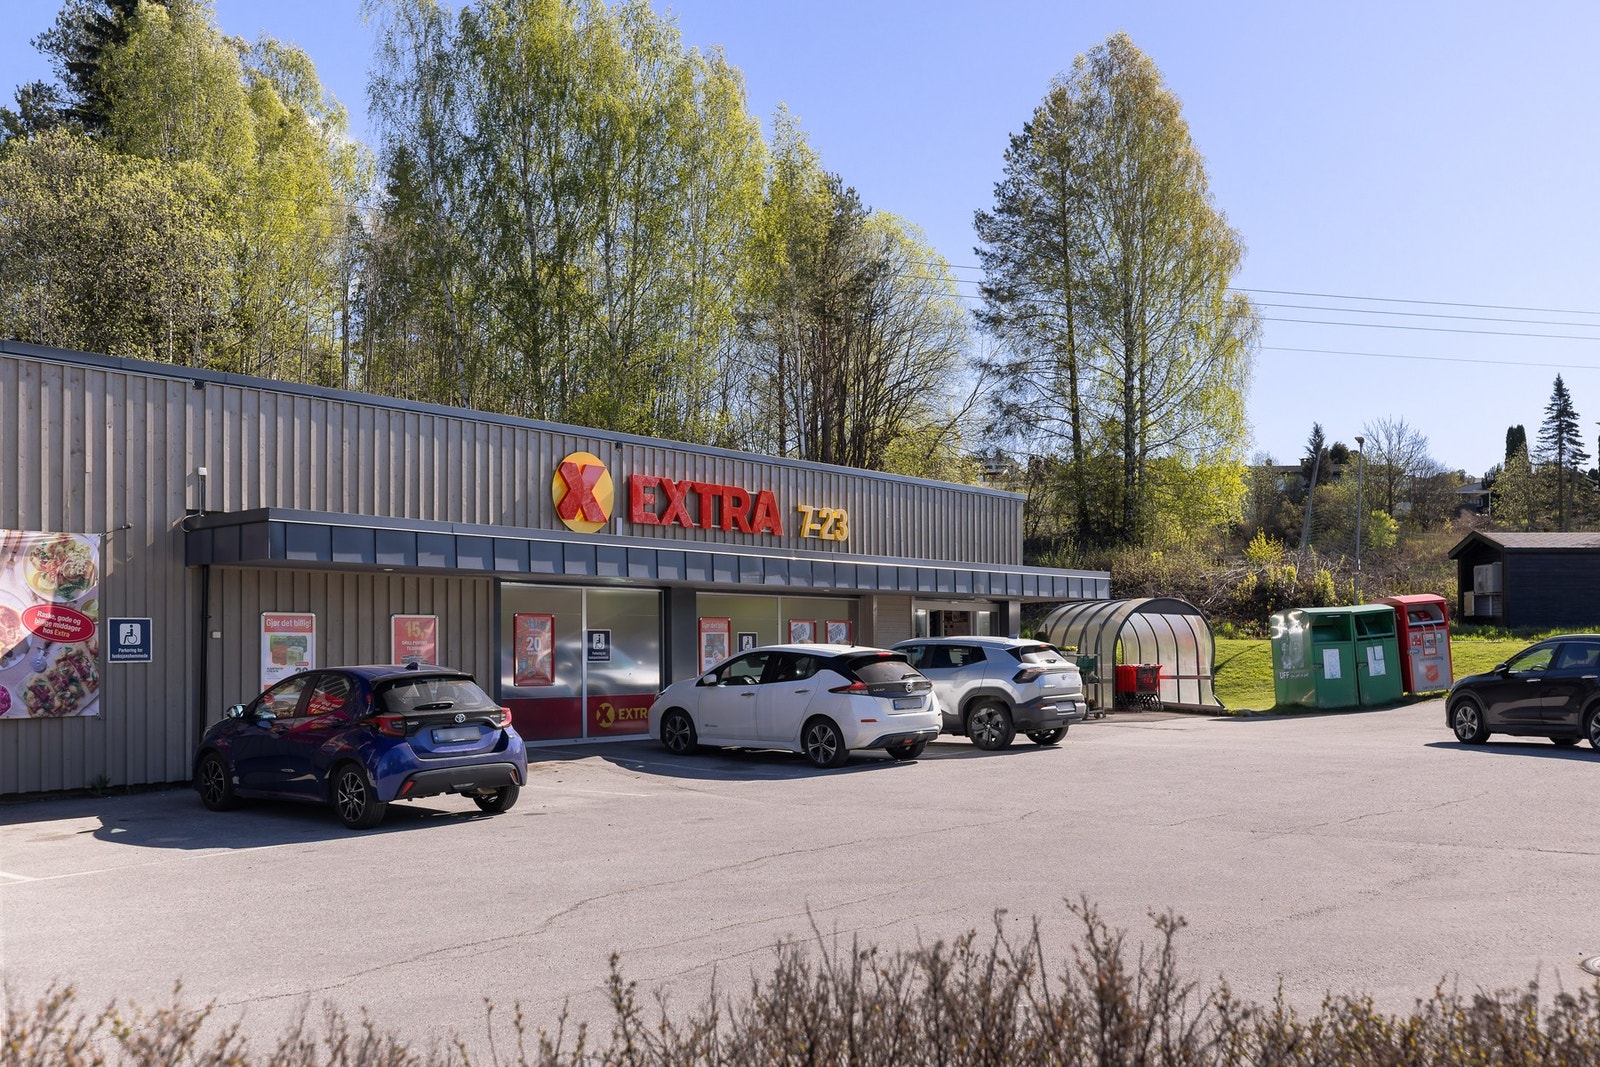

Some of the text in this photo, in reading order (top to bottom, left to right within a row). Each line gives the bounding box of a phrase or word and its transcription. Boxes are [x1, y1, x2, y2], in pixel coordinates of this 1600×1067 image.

[629, 473, 785, 536] EXTRA
[798, 504, 849, 541] 7-23
[36, 610, 57, 620] Raske,
[57, 615, 73, 623] gode
[53, 621, 81, 632] middager
[266, 618, 312, 629] Gjør det billig!
[42, 627, 70, 638] hos Extra
[526, 636, 542, 651] 20
[618, 707, 648, 720] EXTR
